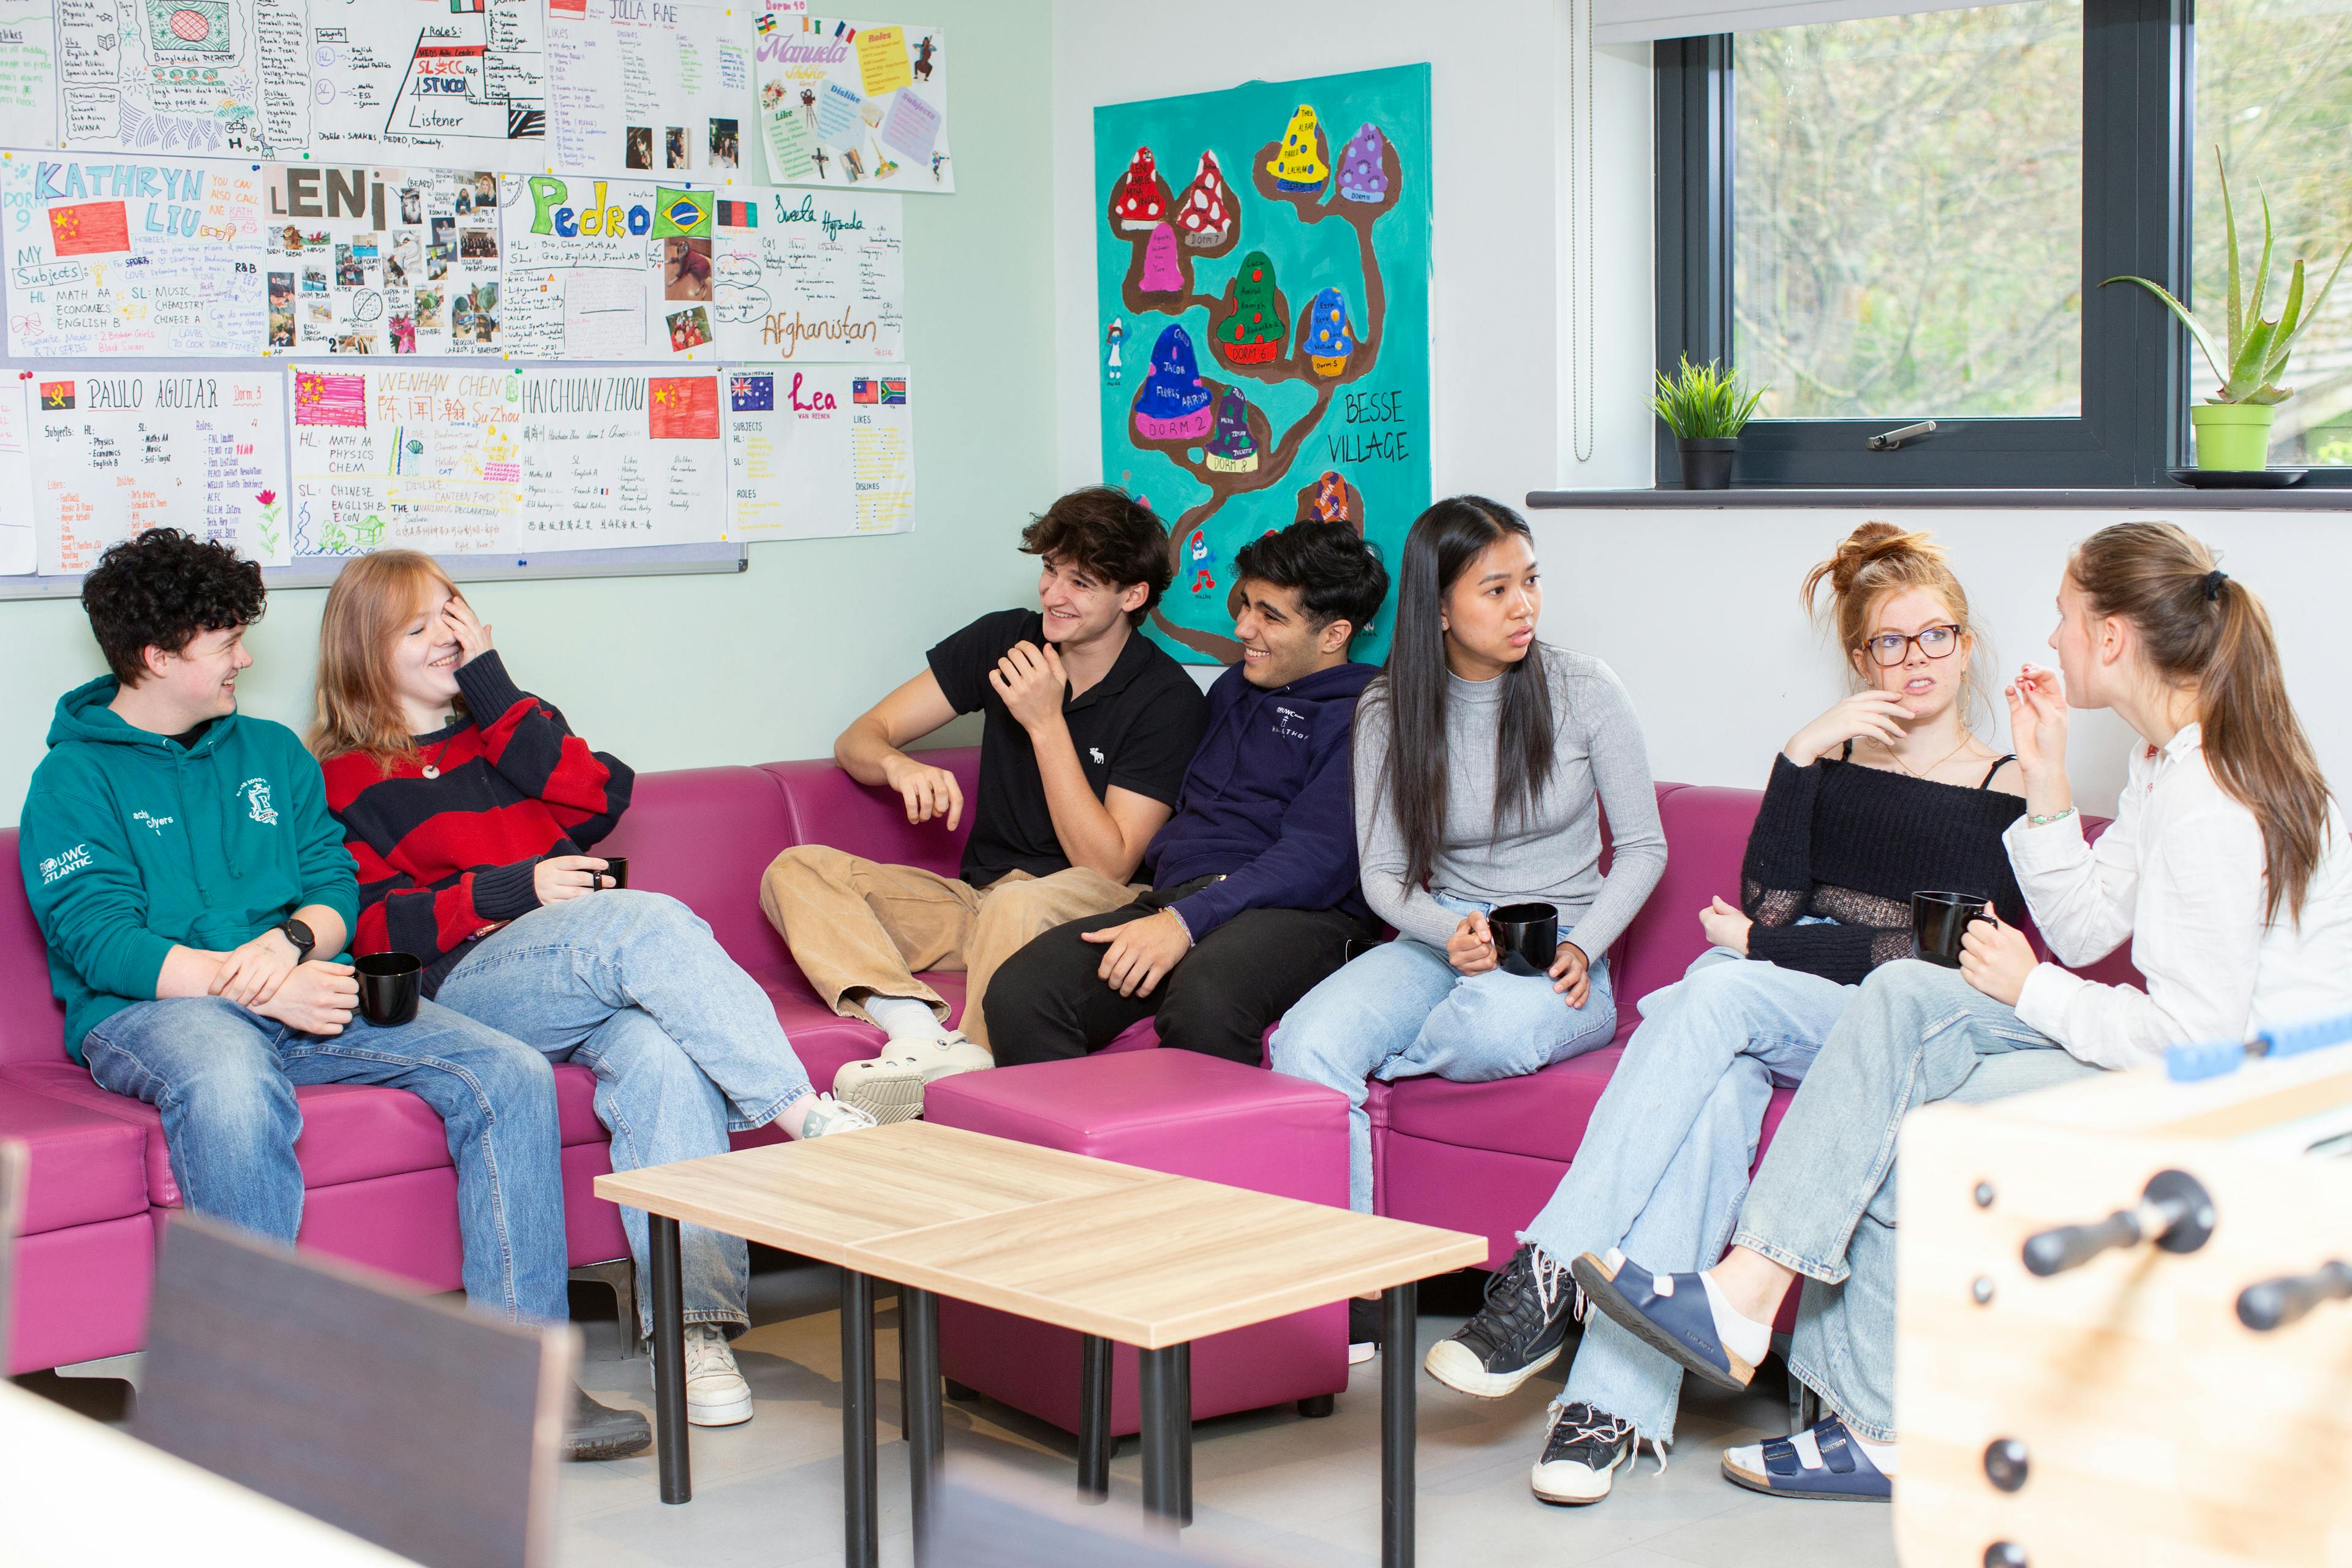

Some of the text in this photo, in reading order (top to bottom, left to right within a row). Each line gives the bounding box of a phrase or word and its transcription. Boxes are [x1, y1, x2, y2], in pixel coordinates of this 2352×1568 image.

[766, 0, 805, 10] Dorm 10
[608, 0, 677, 23] JOLLA RAE
[869, 32, 892, 42] Roles
[756, 33, 848, 63] Manuela
[67, 50, 89, 59] English
[154, 53, 199, 64] Bangladesh
[423, 78, 466, 93] STUCO
[831, 85, 861, 104] Dislike
[176, 99, 196, 109] people
[902, 92, 937, 119] Subjects
[410, 105, 464, 127] Listener
[775, 110, 793, 121] Like
[1284, 148, 1299, 158] PAULO
[1132, 164, 1147, 175] LENI
[36, 162, 205, 202] KATHRYN
[212, 174, 252, 189] YOU CAN
[407, 176, 434, 190] (BEARD)
[1126, 186, 1144, 195] MINA
[4, 192, 49, 209] DORM
[211, 190, 259, 205] ALSO CALL
[229, 207, 252, 217] KATH
[16, 209, 31, 232] 9
[146, 203, 201, 236] LIU
[1191, 234, 1219, 244] Dorm 7
[18, 246, 41, 265] MY
[56, 288, 111, 301] MATH AA
[156, 287, 190, 298] MUSIC
[155, 300, 204, 311] CHEMISTRY
[57, 318, 121, 330] ENGLISH B
[154, 315, 189, 324] CHINESE
[108, 330, 155, 340] Broken Girls
[328, 338, 337, 353] 2
[1232, 347, 1267, 361] DORM 6
[1163, 361, 1186, 375] JACOB
[378, 372, 502, 397] WENHAN CHEN
[87, 378, 252, 409] PAULO AGUIAR Dorm
[523, 377, 645, 413] HAICHUAN ZHOU
[788, 372, 837, 412] Lea
[1156, 385, 1180, 399] FLORIS
[1182, 391, 1208, 408] AARON
[378, 395, 466, 423] 陈闻瀚
[1345, 391, 1405, 424] BESSE
[196, 420, 213, 431] Roles:
[853, 415, 872, 424] LIKES
[138, 423, 147, 431] SL:
[733, 422, 763, 431] SUBJECTS
[1149, 417, 1207, 437] DORM 2
[45, 426, 74, 442] Subjects:
[85, 425, 115, 448] HL: Physics
[145, 433, 168, 443] Maths AA
[330, 435, 372, 447] MATH AA
[1328, 431, 1409, 463] VILLAGE
[330, 450, 374, 461] PHYSICS
[524, 456, 534, 466] HL
[573, 455, 580, 465] SL
[93, 460, 113, 469] English
[329, 462, 365, 472] CHEM
[1214, 457, 1248, 472] DORM 8
[243, 479, 263, 489] Taskforce
[331, 483, 374, 497] CHINESE
[435, 492, 495, 502] CANTEEN FOOD
[737, 489, 756, 499] ROLES
[1319, 483, 1335, 507] ERNA
[206, 505, 222, 514] AILEM
[332, 501, 374, 510] ENGLISH
[391, 504, 409, 513] THE
[454, 506, 499, 517] DECLARATION
[1322, 502, 1340, 521] ANNIE
[334, 513, 360, 522] ECON
[208, 528, 236, 538] BESSE BOY
[1281, 707, 1295, 717] UWC
[56, 843, 89, 866] UWC
[43, 855, 93, 885] ATLANTIC
